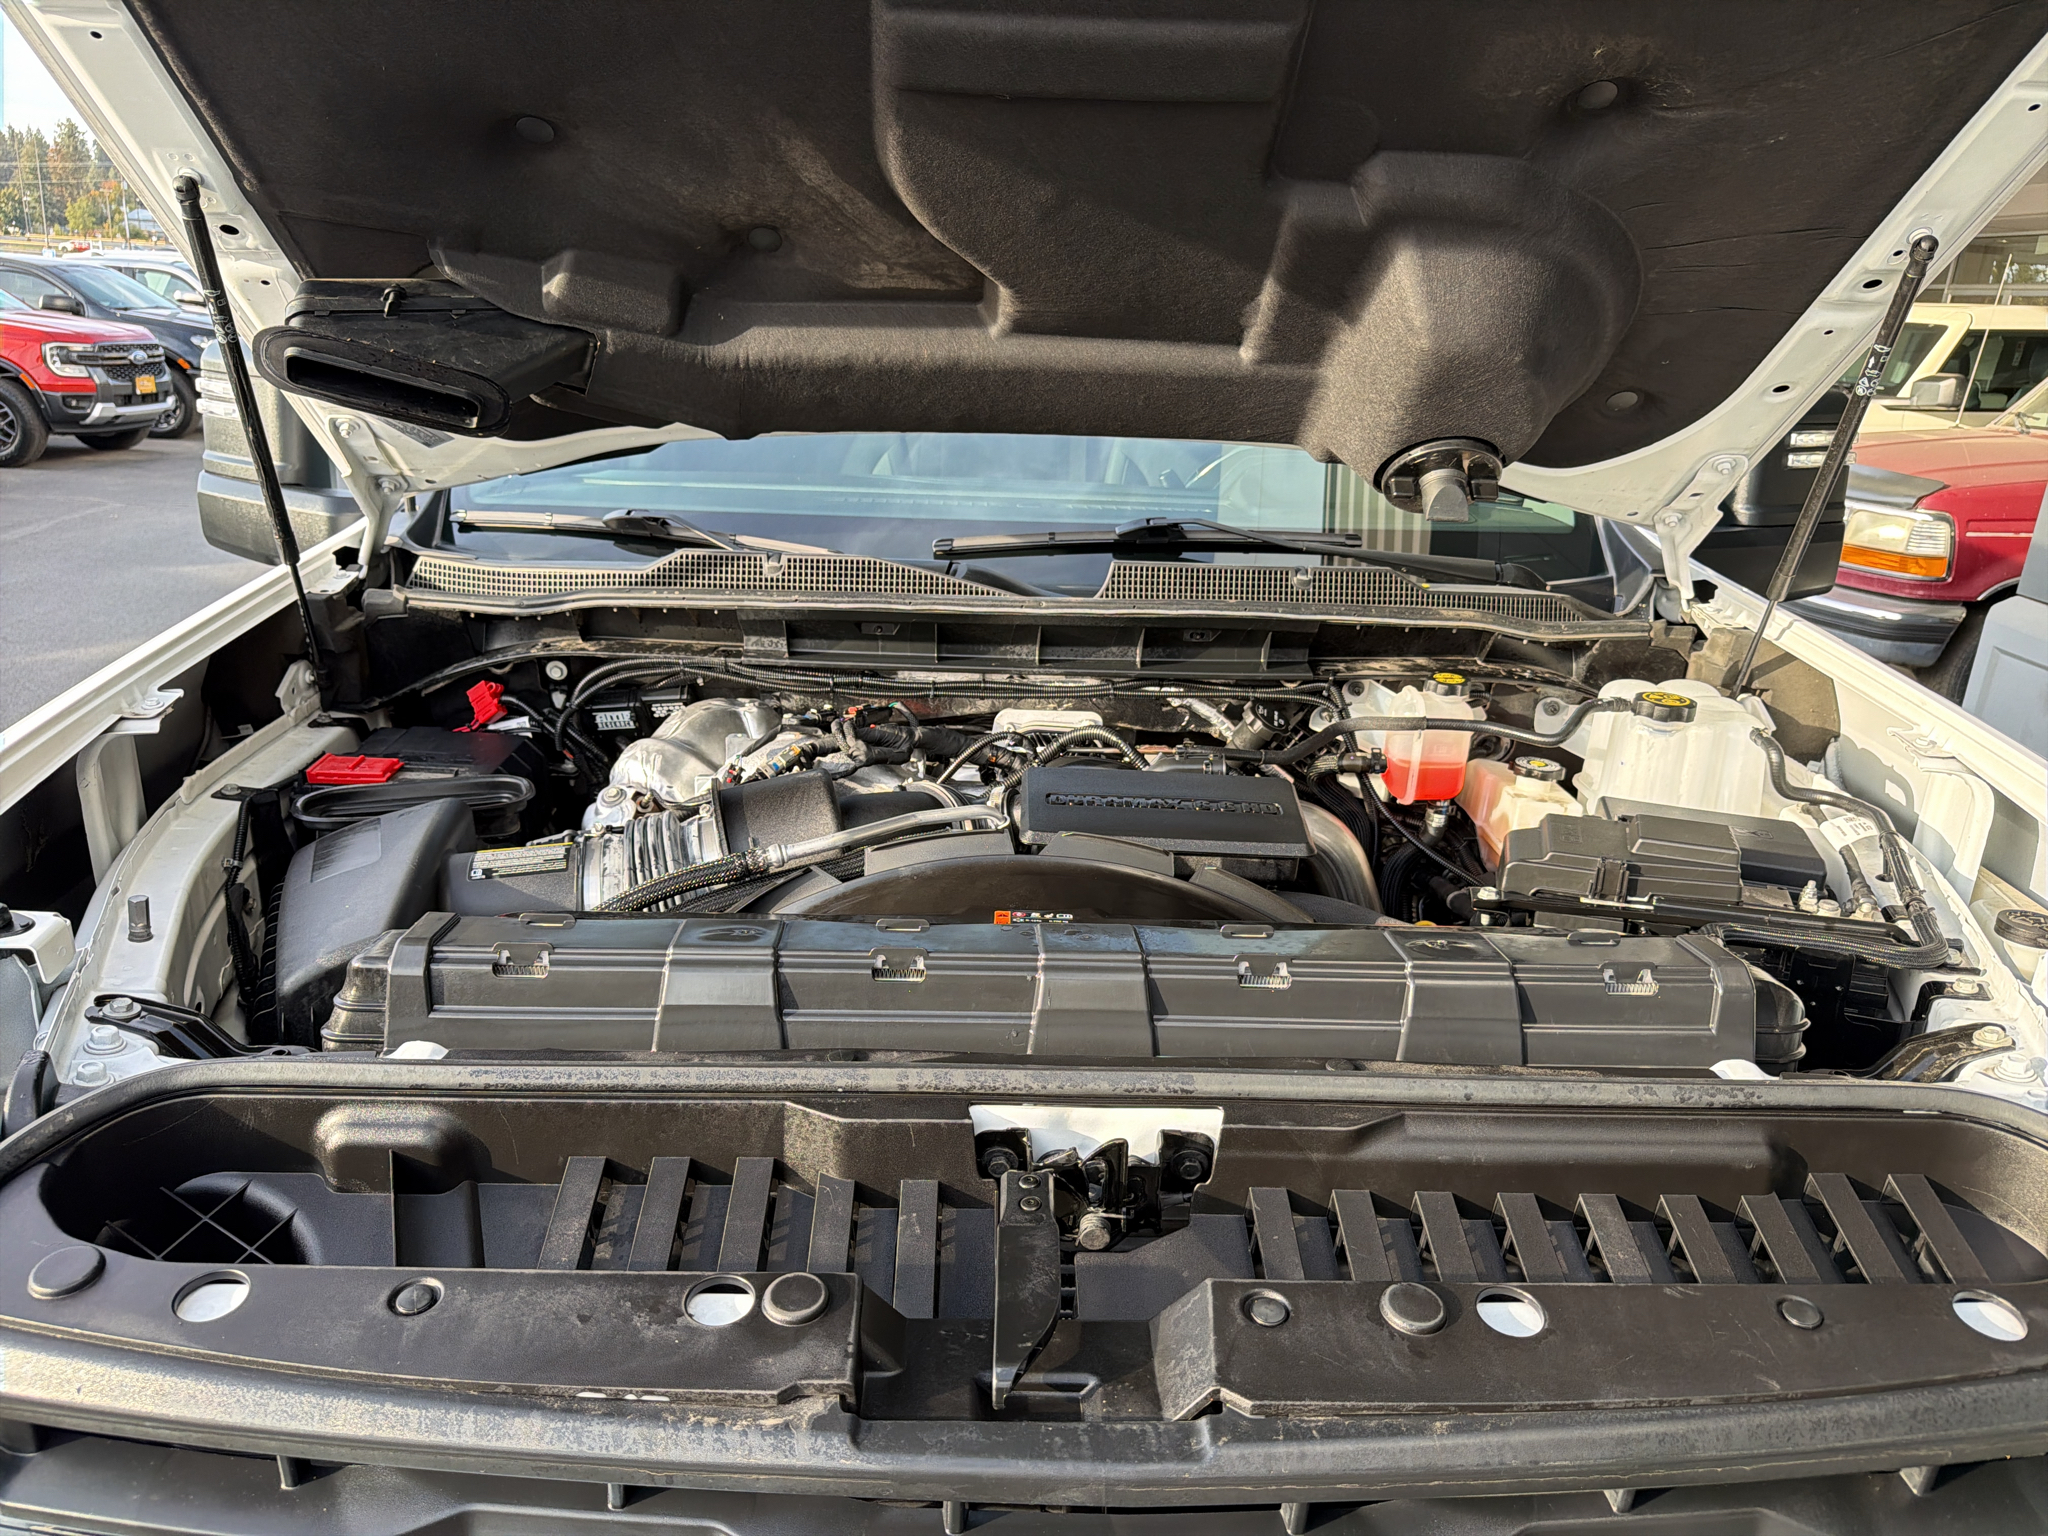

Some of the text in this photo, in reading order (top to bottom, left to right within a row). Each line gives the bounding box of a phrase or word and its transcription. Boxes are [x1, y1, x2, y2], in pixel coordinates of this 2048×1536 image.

[597, 720, 636, 730] RESEARCH
[1049, 794, 1278, 815] DURAMAX 6.6 HD
